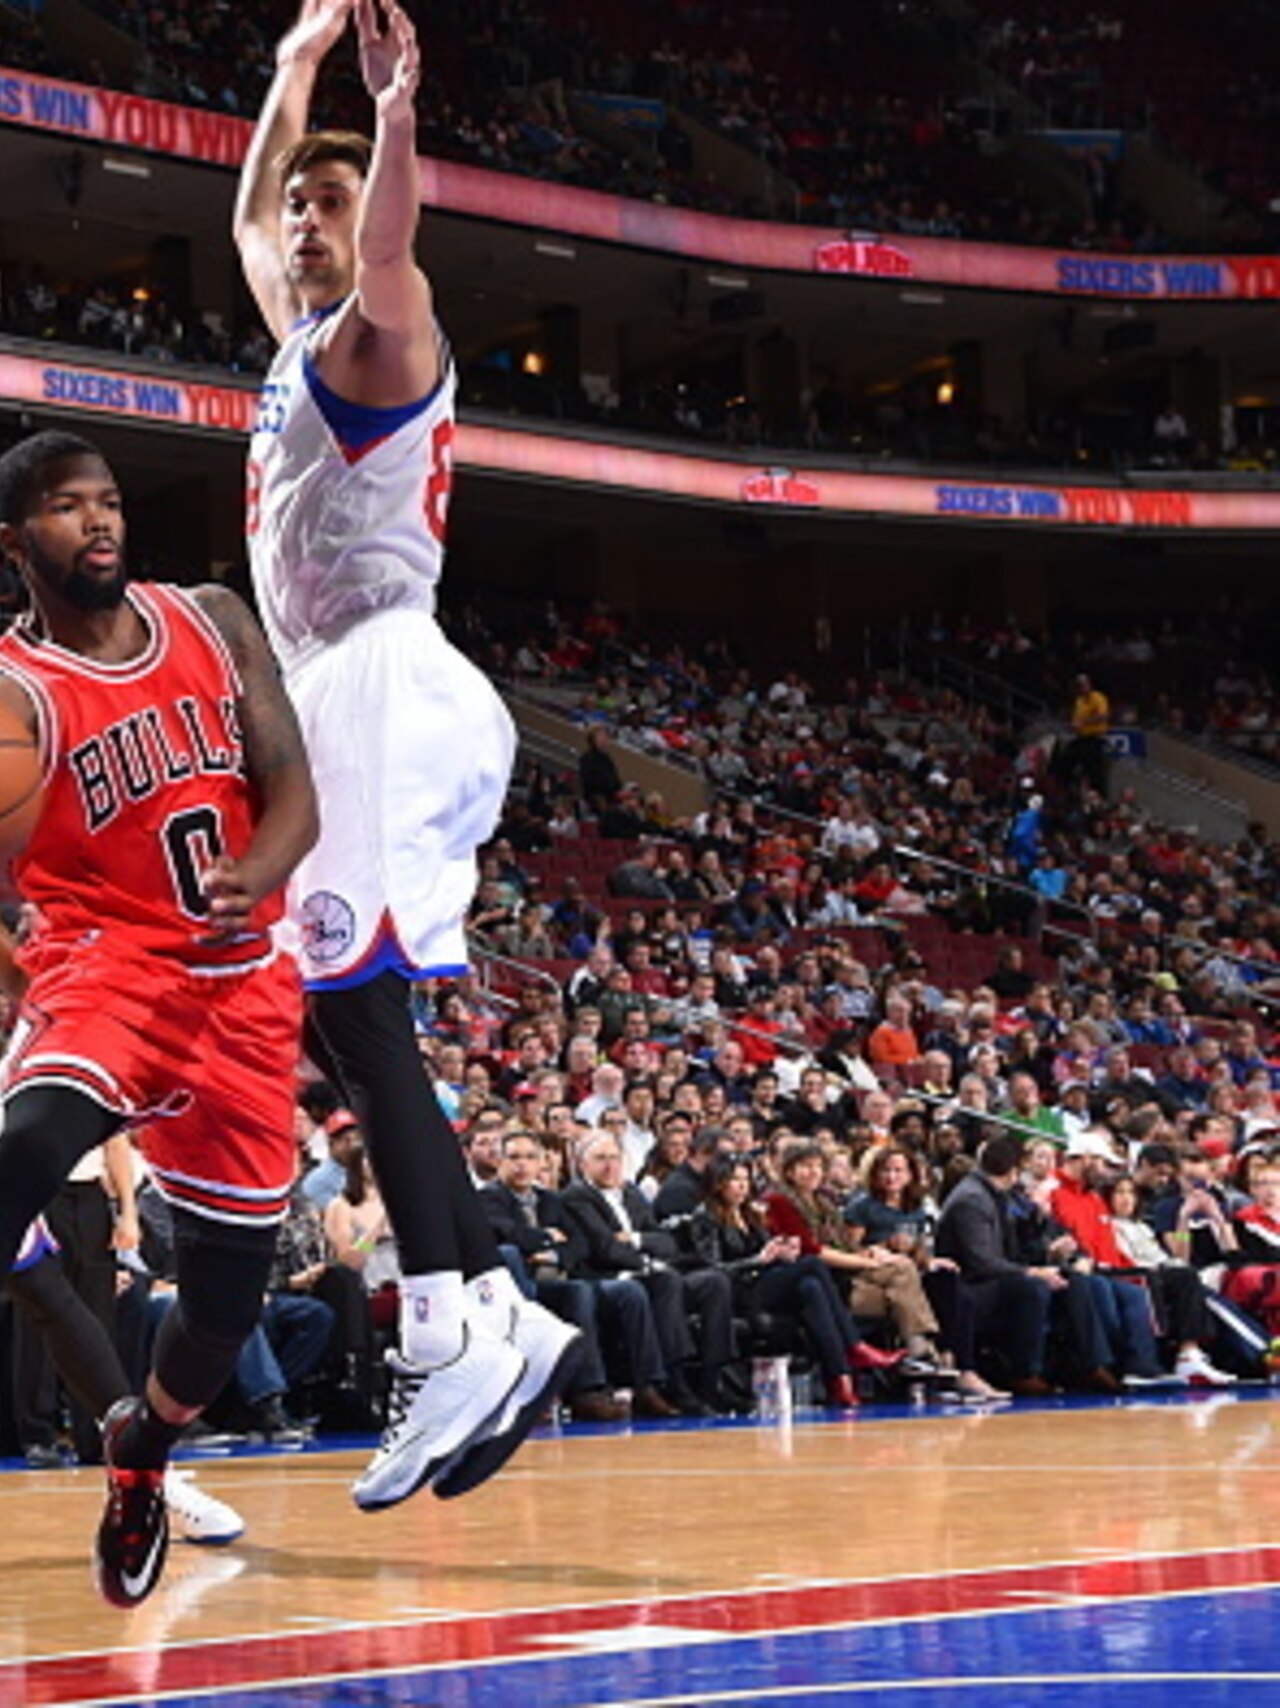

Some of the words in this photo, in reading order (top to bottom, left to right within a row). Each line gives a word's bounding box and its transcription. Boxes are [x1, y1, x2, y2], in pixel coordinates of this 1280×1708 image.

[29, 85, 89, 129] WIN
[95, 90, 178, 150] YOU
[1056, 258, 1156, 293] SIXERS
[1163, 264, 1222, 293] WIN
[43, 368, 127, 408] SIXERS
[133, 382, 181, 416] WIN
[184, 384, 248, 430] YOU
[936, 485, 1013, 514] SIXERS
[1016, 490, 1061, 516] WIN
[1062, 488, 1122, 524] YOU
[1127, 491, 1193, 527] WIN
[160, 803, 224, 921] 0
